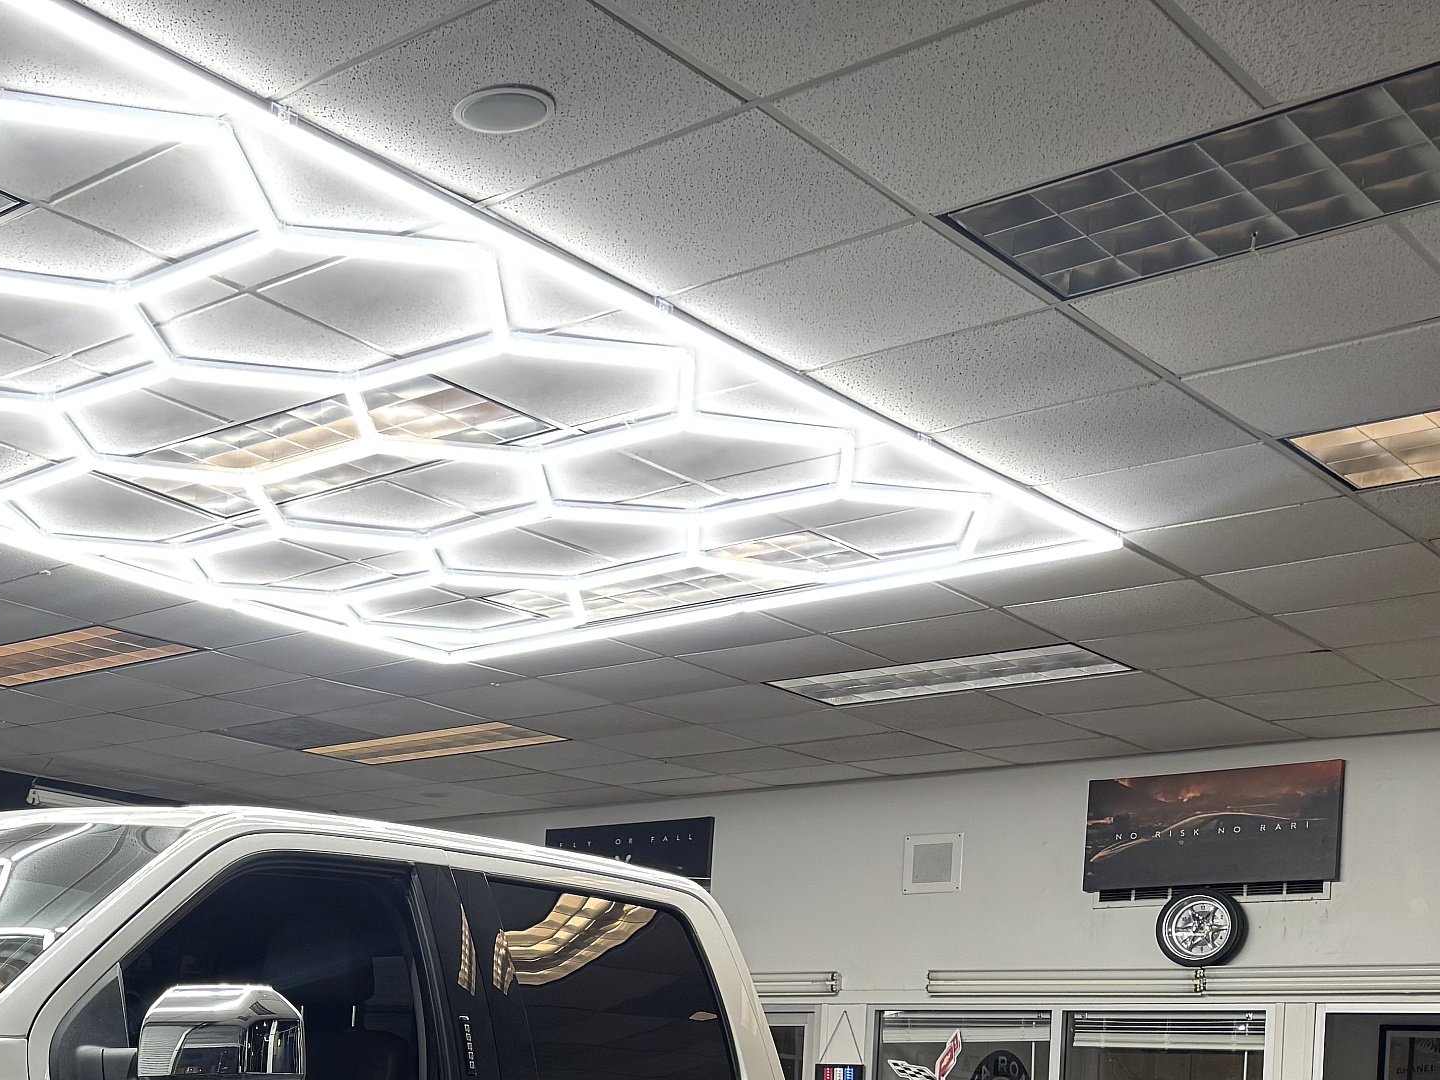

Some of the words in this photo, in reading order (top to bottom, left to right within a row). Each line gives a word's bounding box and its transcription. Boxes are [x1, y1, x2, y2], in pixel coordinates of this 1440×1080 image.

[1115, 832, 1138, 841] NO
[1154, 828, 1200, 839] RISK
[1217, 825, 1242, 835] NO
[1260, 821, 1310, 832] RARI
[559, 840, 592, 849] FLY
[614, 837, 634, 846] OR
[650, 833, 693, 843] FALL
